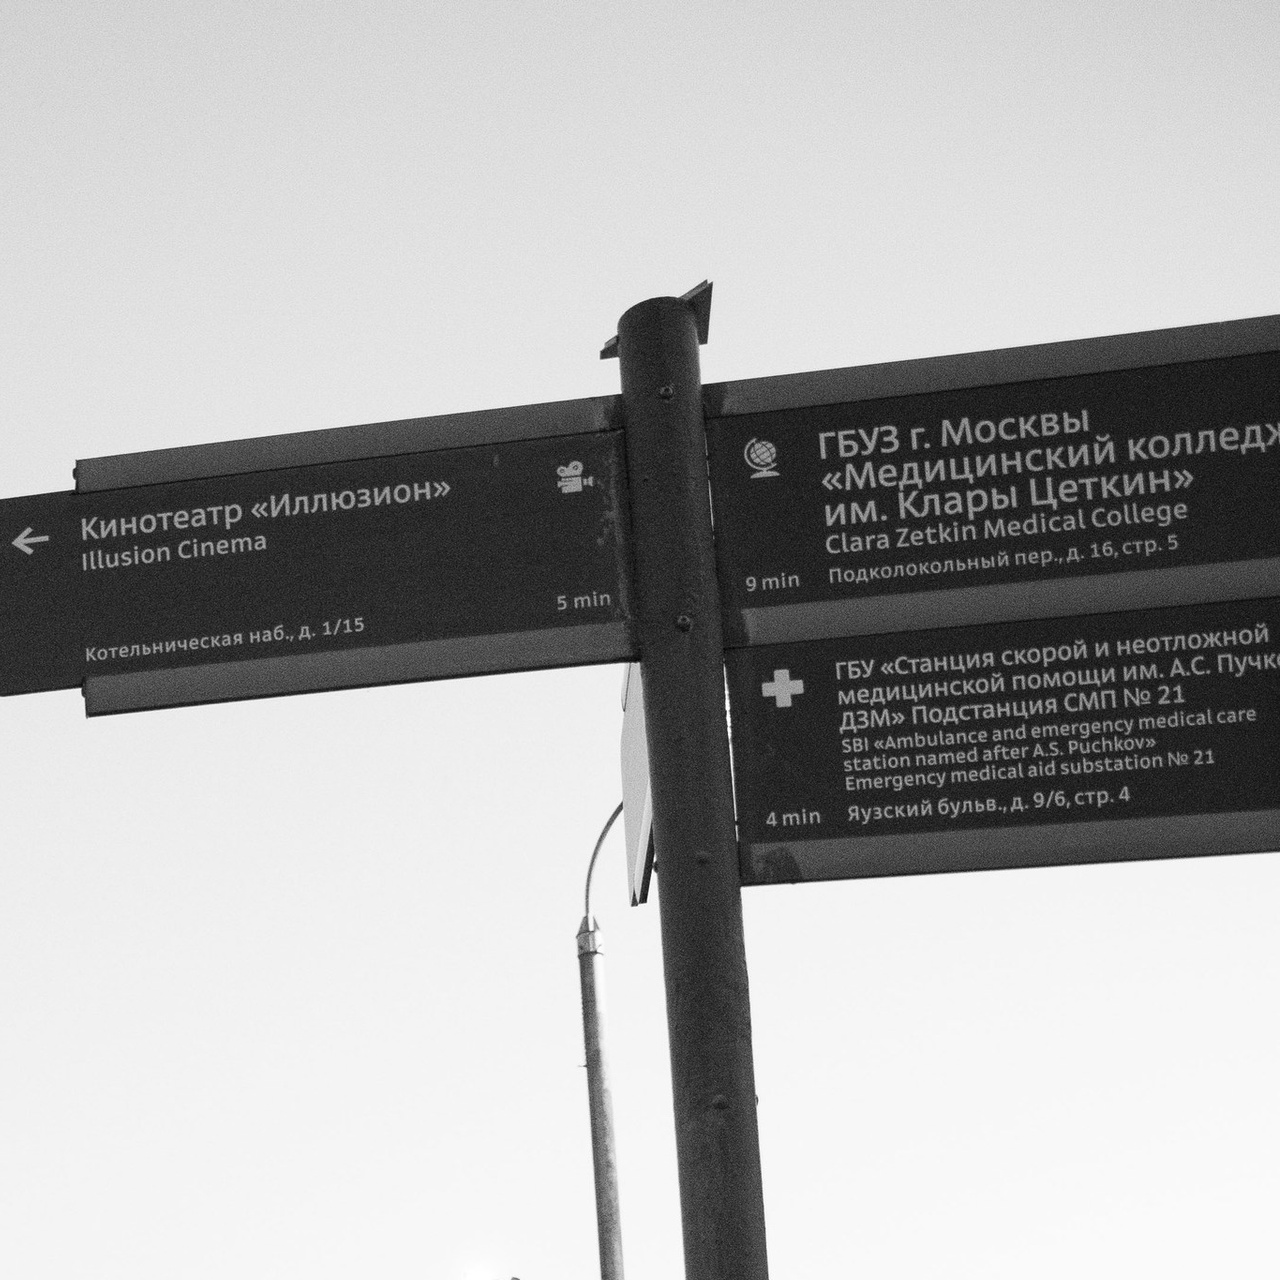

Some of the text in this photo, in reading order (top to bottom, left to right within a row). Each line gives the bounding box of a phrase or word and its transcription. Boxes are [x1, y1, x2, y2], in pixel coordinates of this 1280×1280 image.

[819, 409, 1089, 459] ГБУЗ г. Москвы
[822, 434, 1115, 491] «Медицинский
[81, 481, 451, 540] Кинотеатр «Иллюзион»
[825, 470, 1194, 526] им. Клары Цеткин»
[826, 503, 1187, 554] Clara Zetkin Medical College
[82, 535, 267, 571] Illusion Cinema
[829, 534, 1178, 583] Подколокольный пер., д. 16, стр. 5
[557, 591, 611, 610] 5 min
[746, 573, 800, 592] 9 min
[86, 617, 364, 661] Котельническая наб., д. 1/15
[836, 623, 1269, 680] ГБУ «Станция скорой и неотложной
[838, 653, 1280, 705] медицинской помощи им. А.С. Пучк
[839, 685, 1185, 734] ДЗМ» Подстанция СМП № 21
[842, 709, 1256, 753] SBI «Ambulance and emergency medical care
[843, 736, 1156, 772] station named after A.S. Puchkov»
[845, 749, 1214, 791] Emergency medical aid substation № 21
[766, 809, 821, 826] 4 min
[848, 786, 1130, 824] Яузский бульв., д. 9/6, стр. 4
